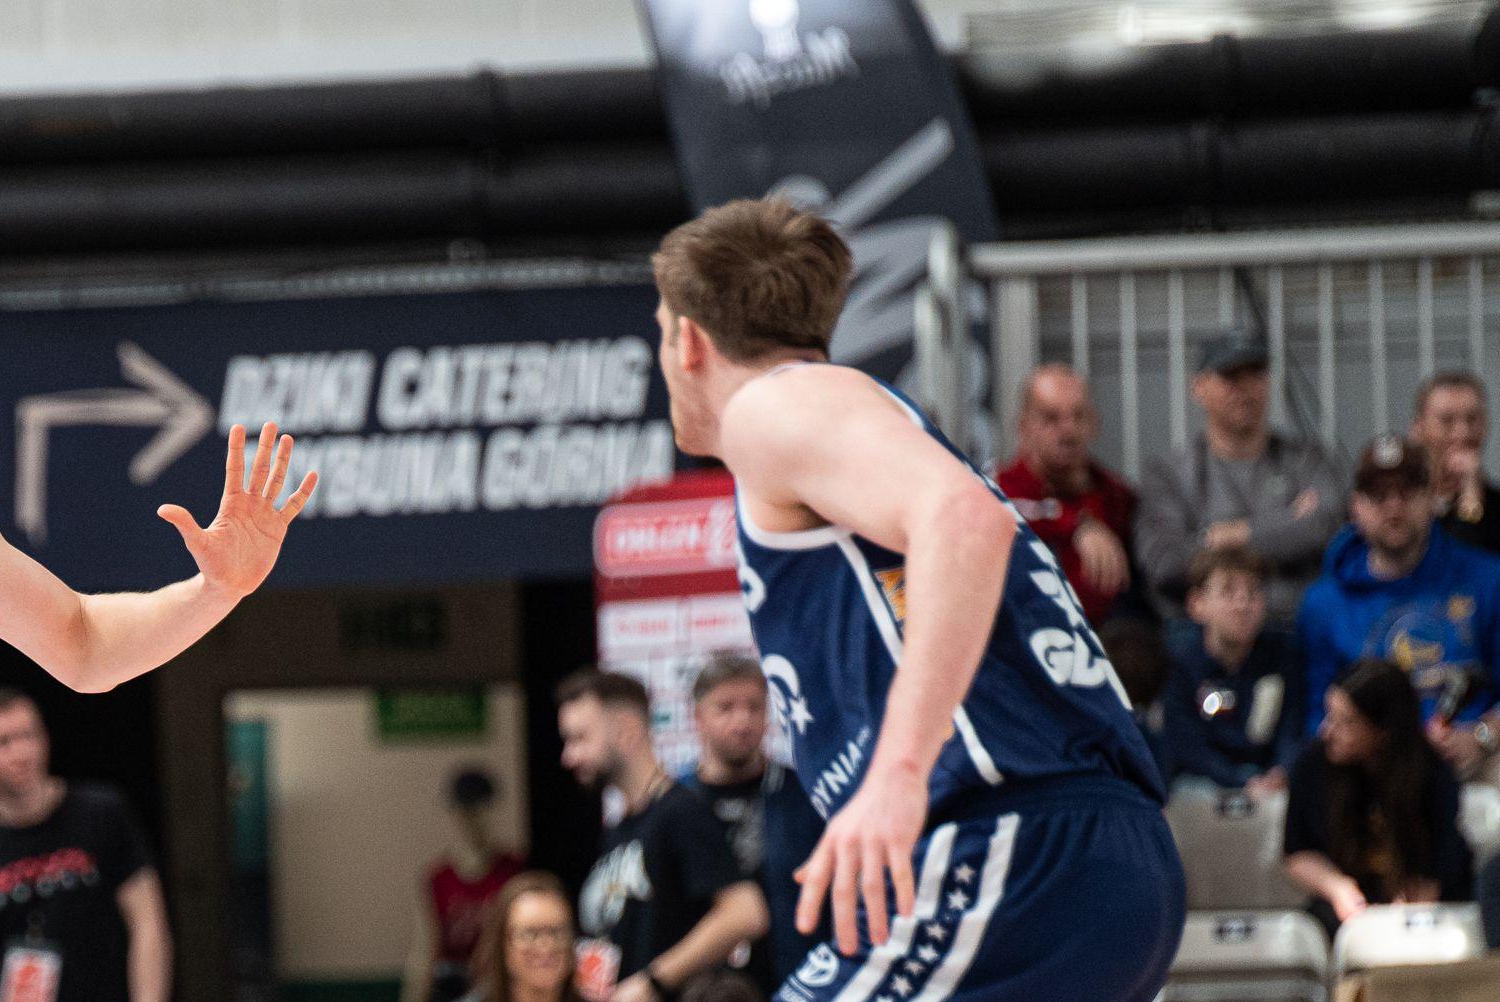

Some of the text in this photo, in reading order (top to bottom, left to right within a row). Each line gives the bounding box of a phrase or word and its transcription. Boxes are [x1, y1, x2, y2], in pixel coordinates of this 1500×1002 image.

[219, 336, 653, 436] DZIKI CATERING
[242, 428, 482, 518] YBUNA
